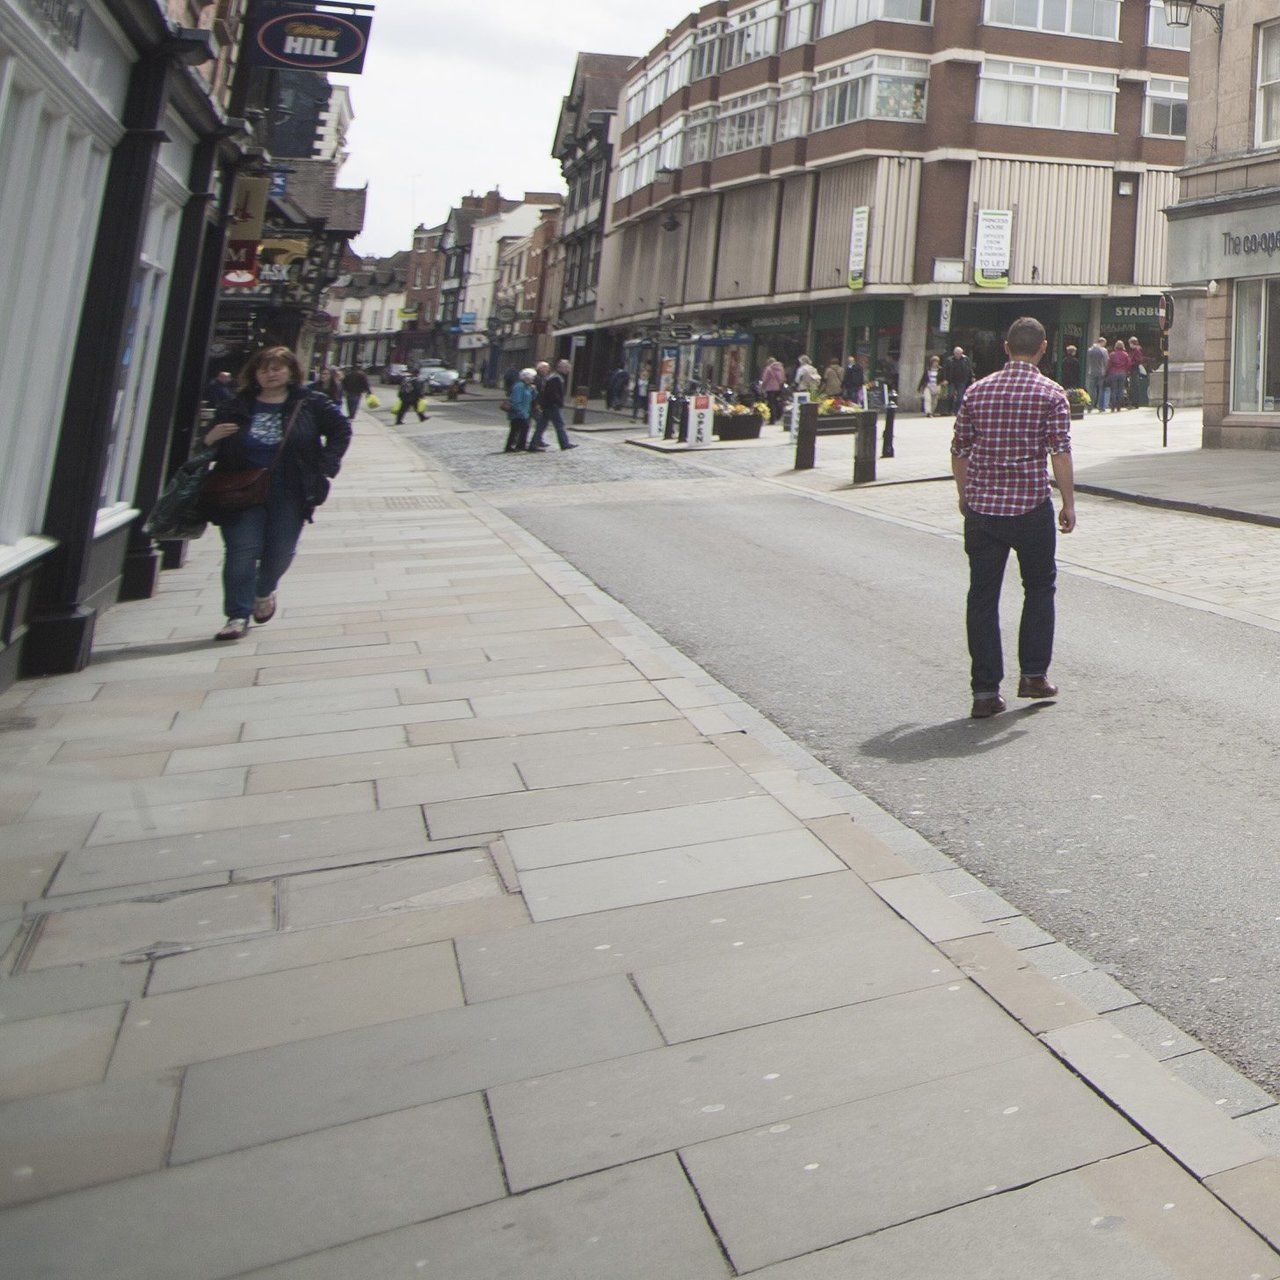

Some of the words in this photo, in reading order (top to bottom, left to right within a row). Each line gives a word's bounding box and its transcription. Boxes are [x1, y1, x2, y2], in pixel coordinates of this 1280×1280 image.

[283, 35, 339, 58] HILL
[1222, 232, 1242, 256] The
[259, 264, 291, 280] ASK
[696, 412, 705, 443] OPEN
